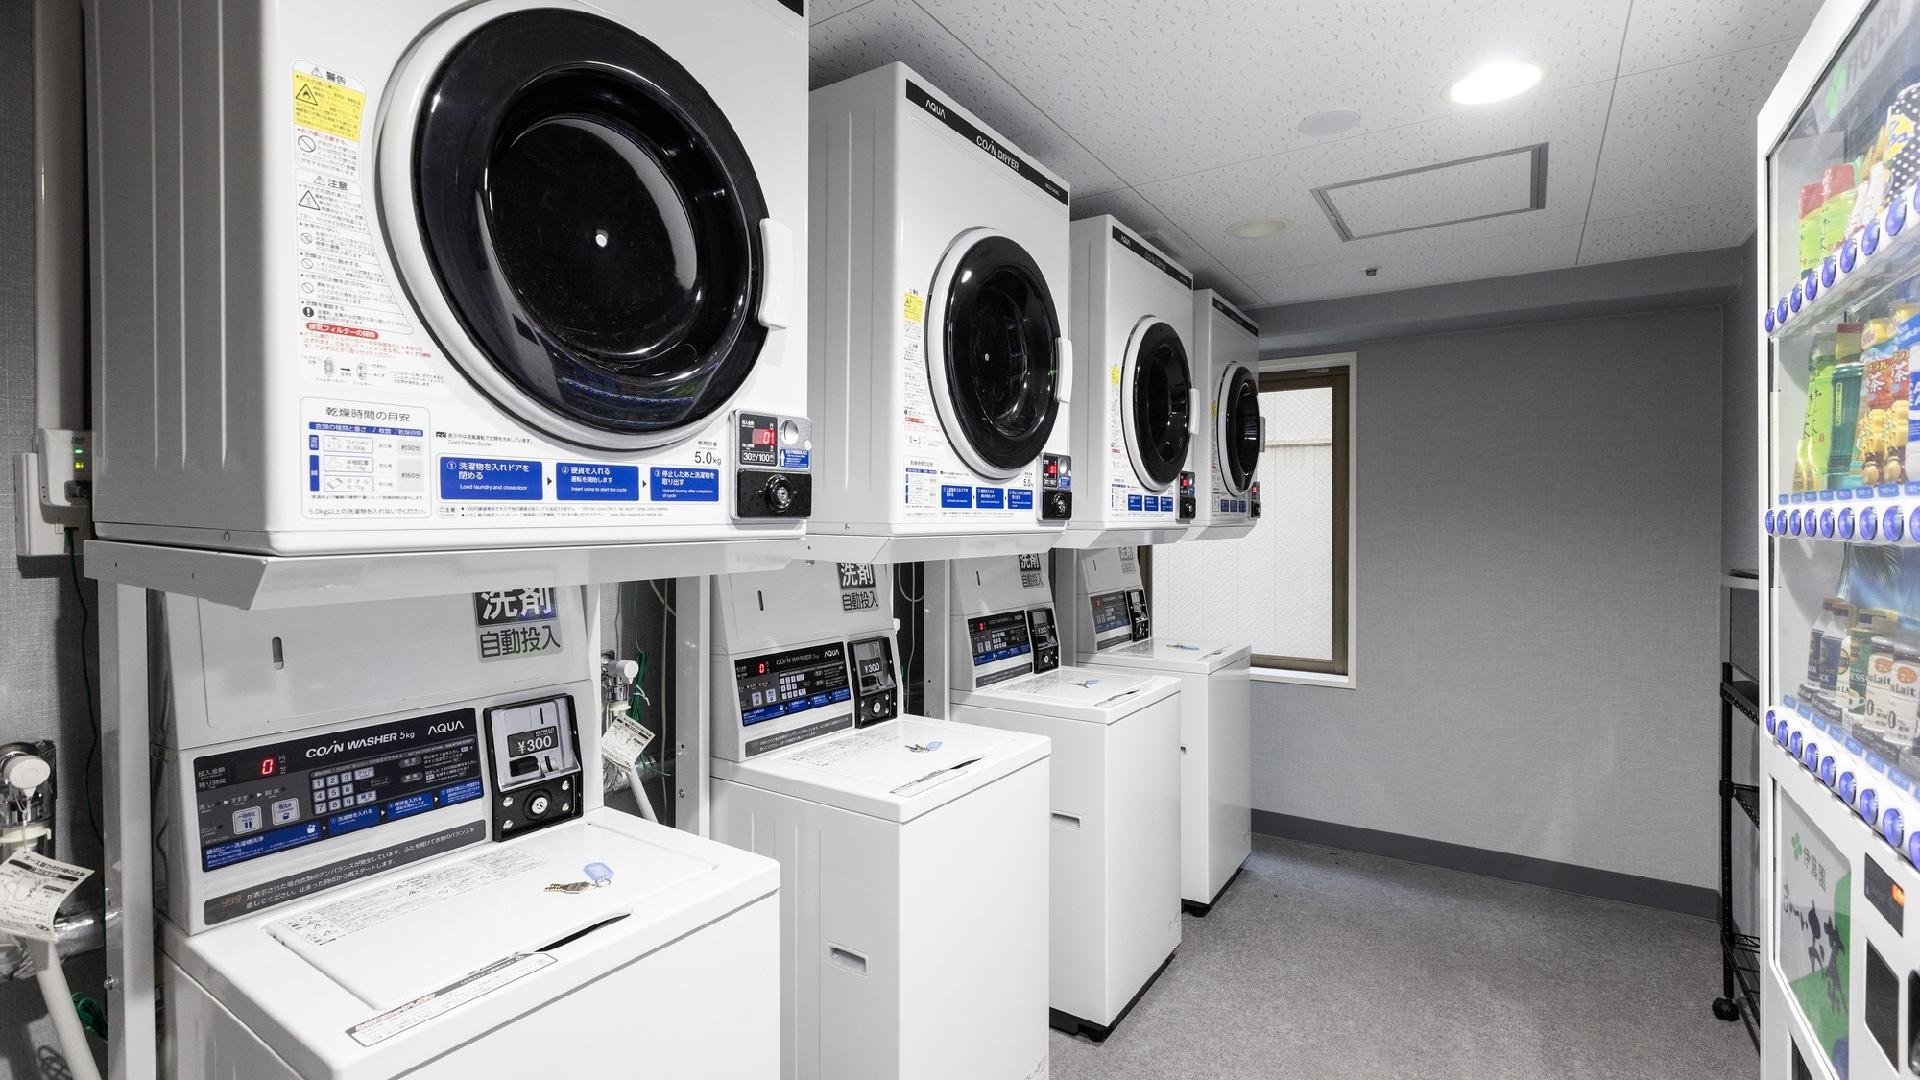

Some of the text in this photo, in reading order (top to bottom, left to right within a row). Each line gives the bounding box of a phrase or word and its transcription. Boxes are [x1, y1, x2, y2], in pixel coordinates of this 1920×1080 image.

[925, 100, 946, 119] AQUA
[976, 135, 1020, 171] COIN DRYER
[325, 407, 410, 422] 乾燥時間の目安
[841, 563, 875, 587] 洗剤
[481, 588, 552, 620] 洗剤
[843, 591, 879, 611] 自動投入
[480, 625, 561, 659] 自動投入
[824, 649, 840, 658] AQUA
[759, 664, 764, 674] 0
[428, 720, 465, 736] AQUA
[306, 732, 416, 758] COIN WASHER 5kg
[518, 735, 552, 755] ¥300
[198, 766, 226, 778] 投入金額
[262, 759, 274, 775] 0
